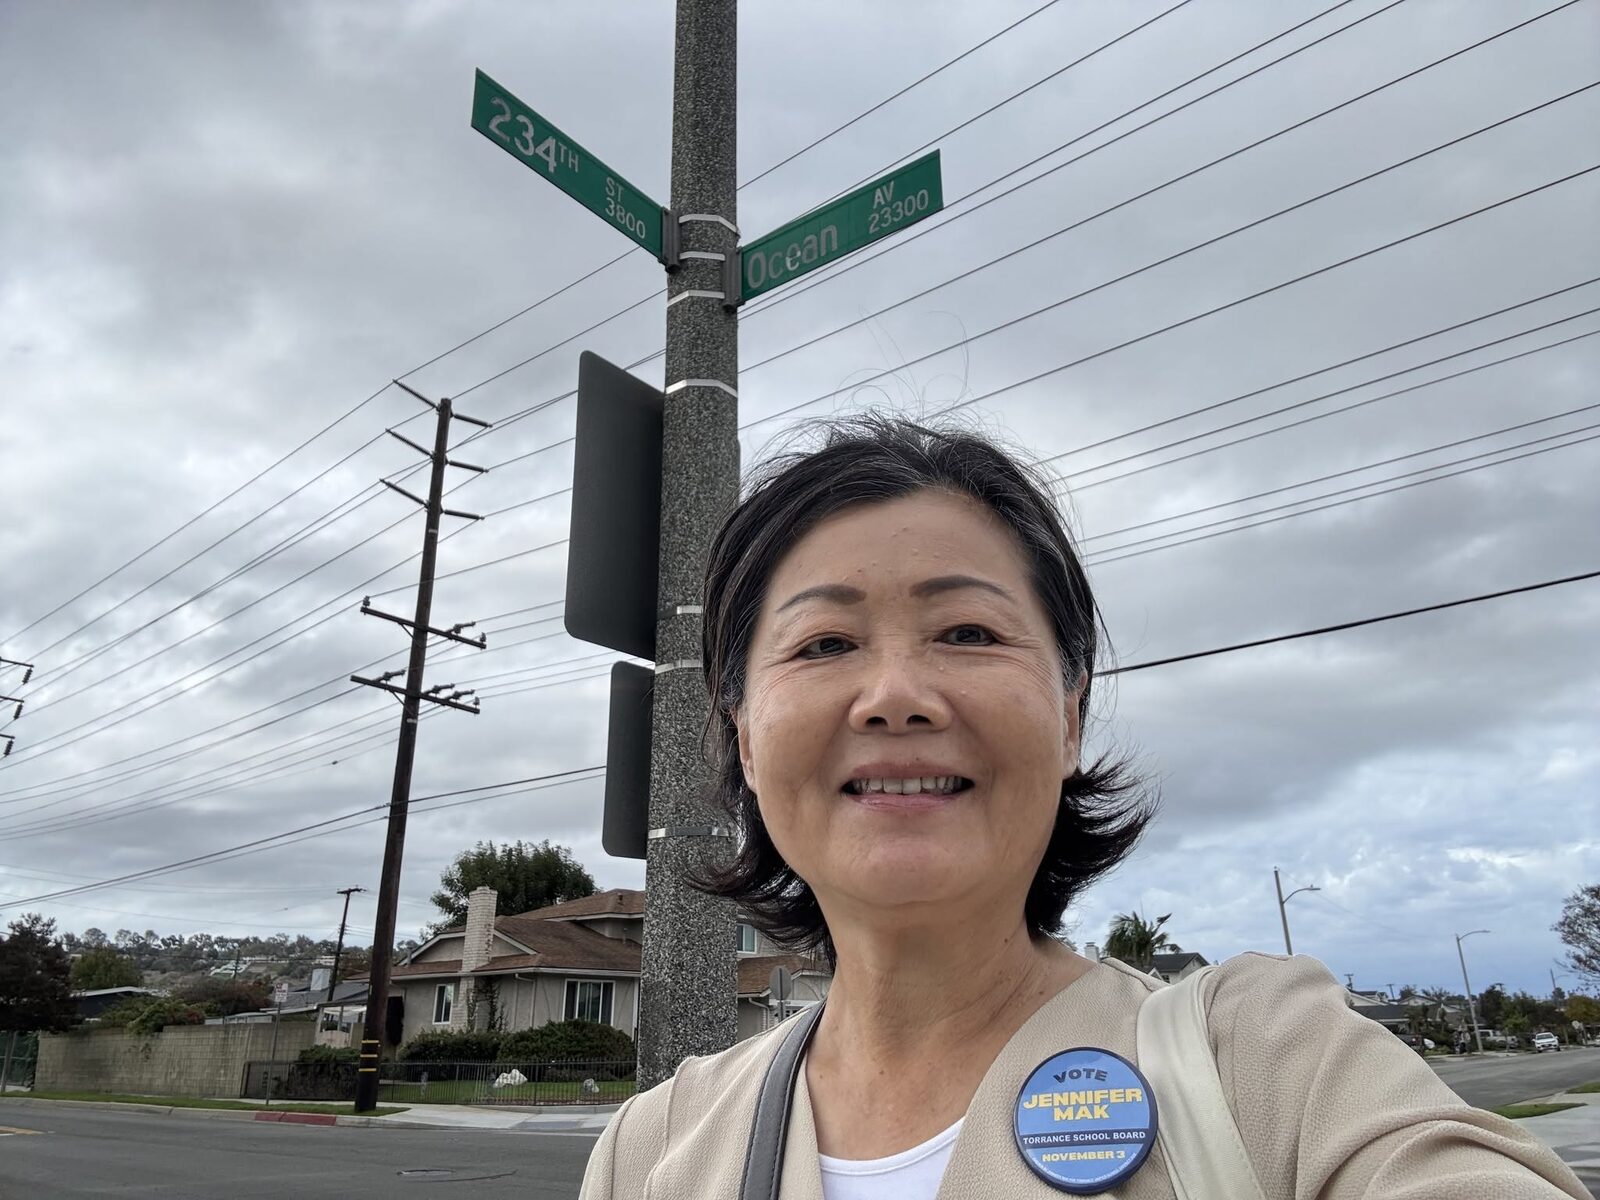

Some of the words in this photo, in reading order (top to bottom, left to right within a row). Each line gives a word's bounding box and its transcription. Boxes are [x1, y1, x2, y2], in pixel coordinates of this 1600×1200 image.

[488, 96, 579, 173] 234TH
[604, 176, 625, 202] ST
[873, 180, 895, 209] AV
[604, 197, 646, 239] 3800
[868, 189, 929, 235] 23300
[747, 225, 838, 289] Ocean
[1053, 1068, 1108, 1084] VOTE
[1023, 1088, 1143, 1109] JENNIFER
[1054, 1104, 1110, 1121] MAK
[1023, 1134, 1070, 1145] TORRANCE
[1072, 1132, 1110, 1142] SCHOOL
[1113, 1131, 1146, 1140] BOARD
[1042, 1151, 1114, 1162] NOVEMBER
[1117, 1150, 1125, 1159] 3
